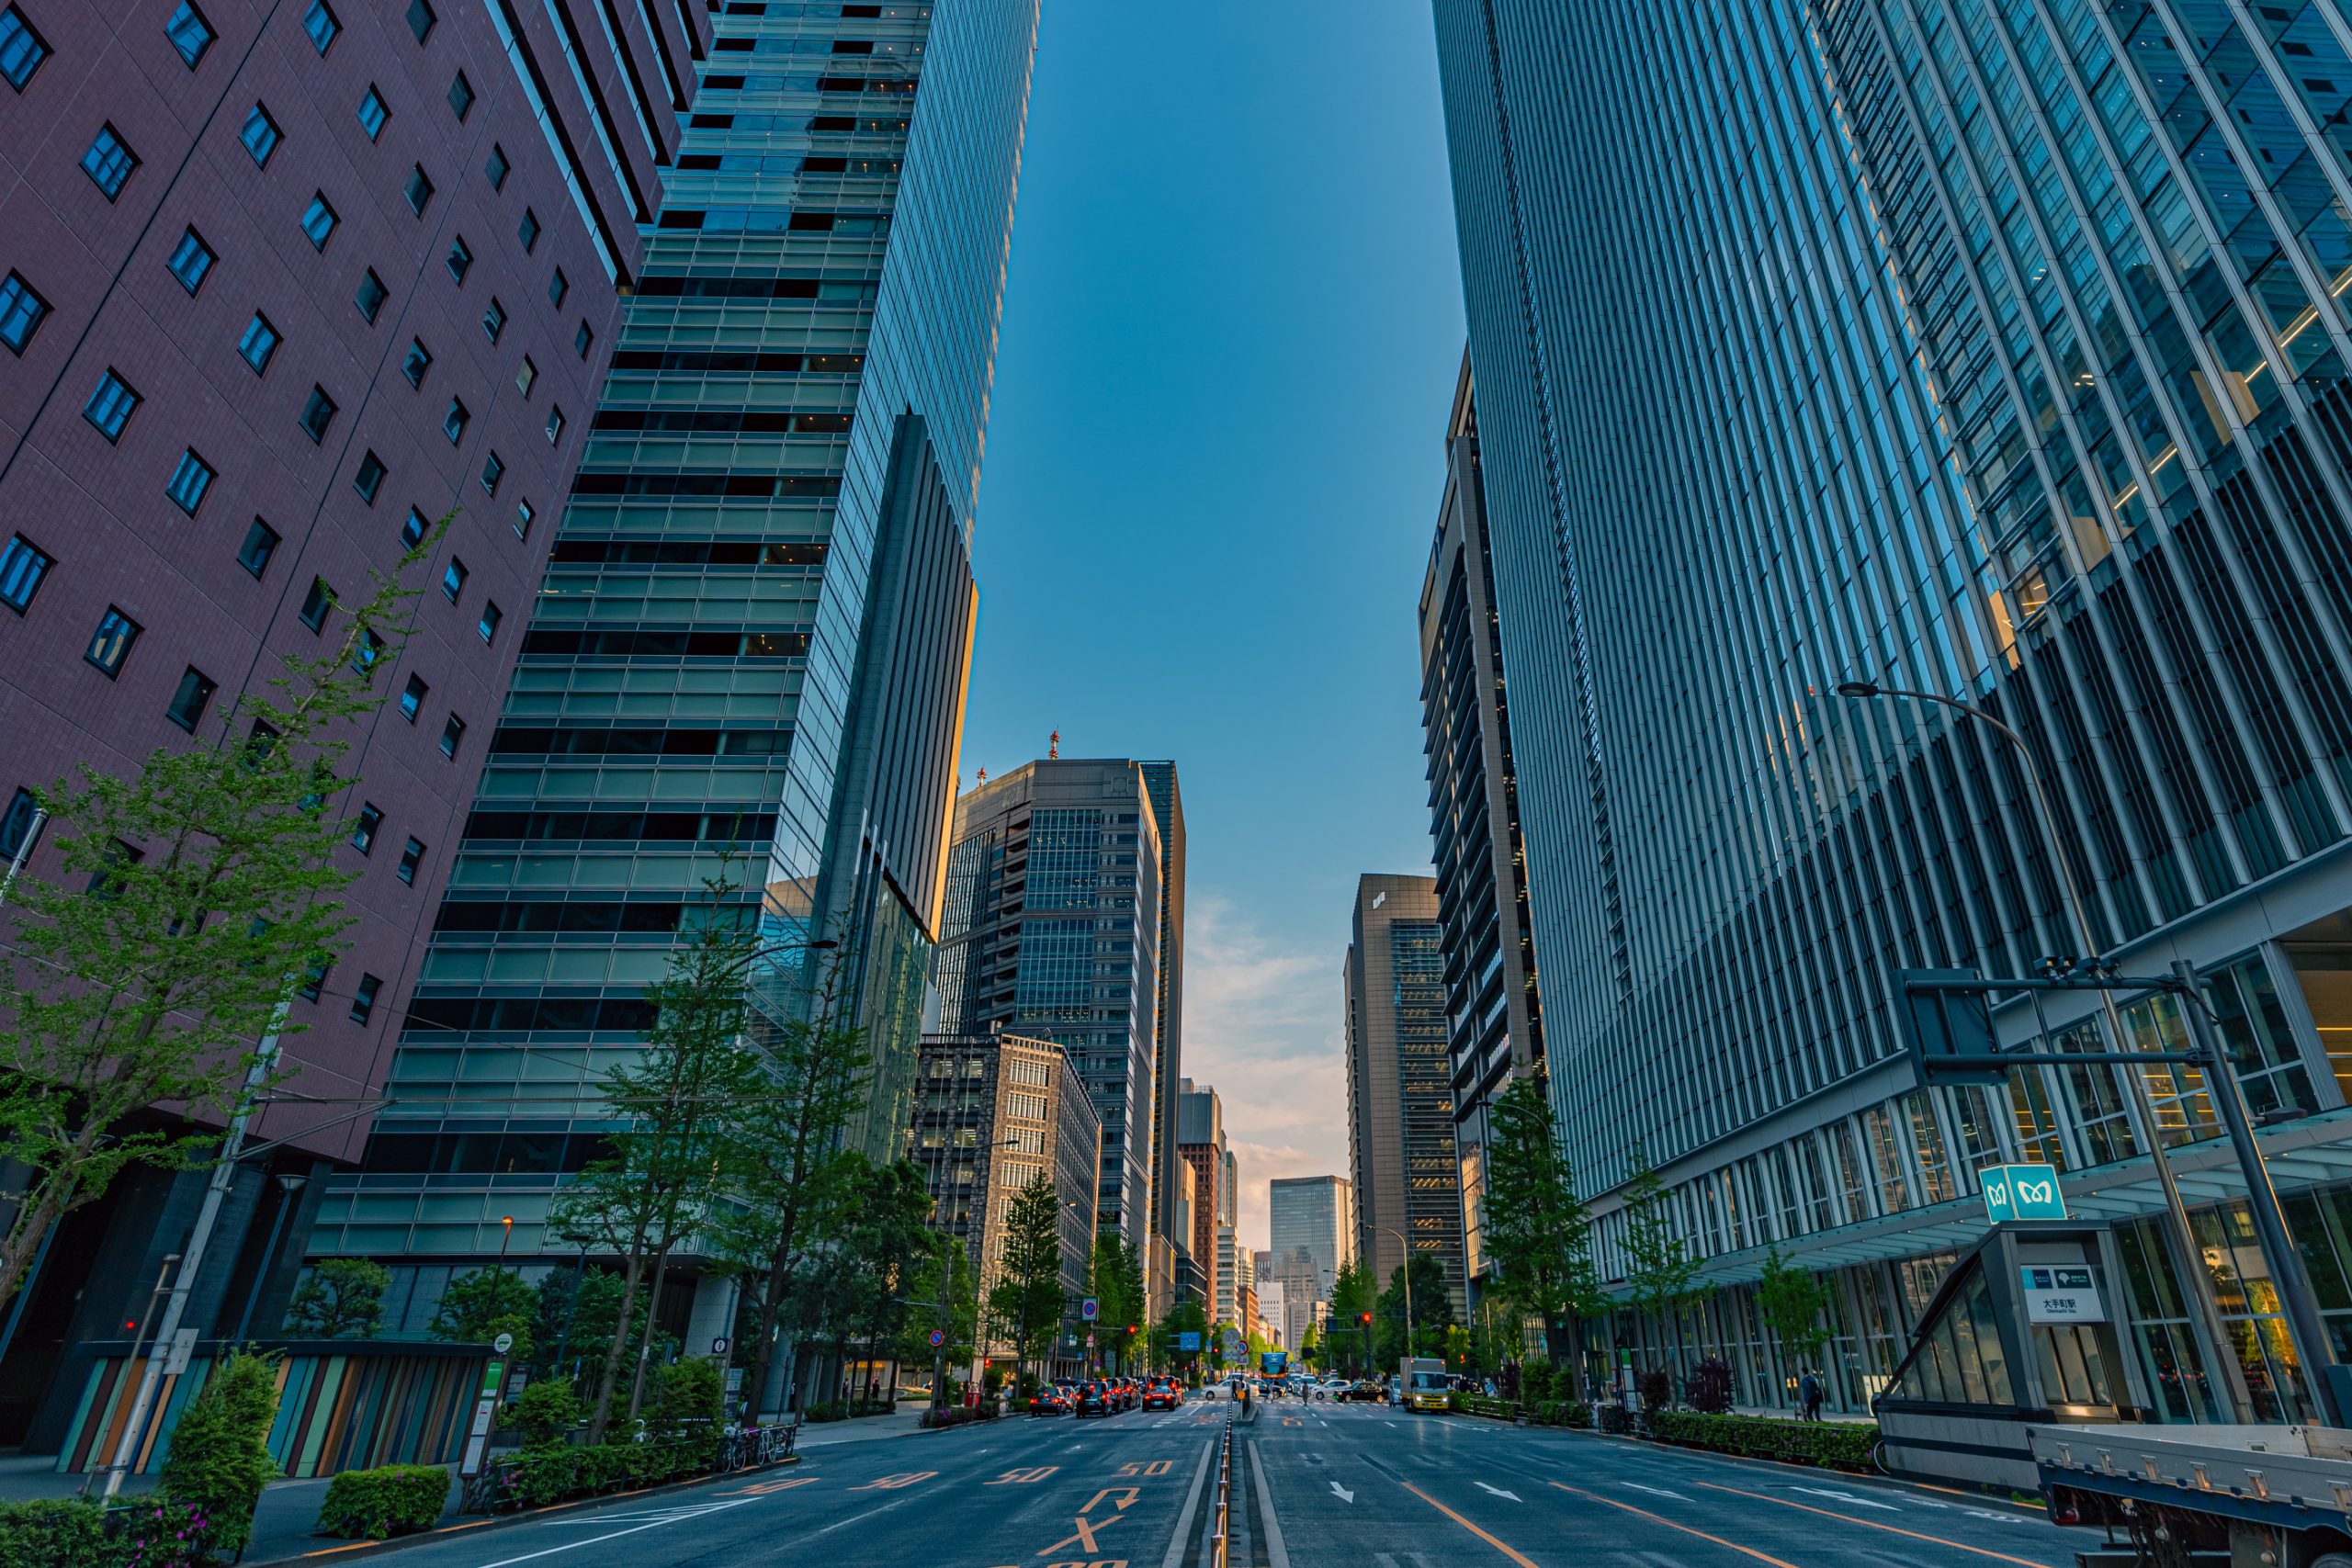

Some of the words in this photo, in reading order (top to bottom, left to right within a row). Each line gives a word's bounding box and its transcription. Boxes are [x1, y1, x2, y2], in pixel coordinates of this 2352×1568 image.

[2043, 1299, 2076, 1309] 大手町駅
[982, 1466, 1059, 1485] 50
[1112, 1461, 1173, 1477] 50
